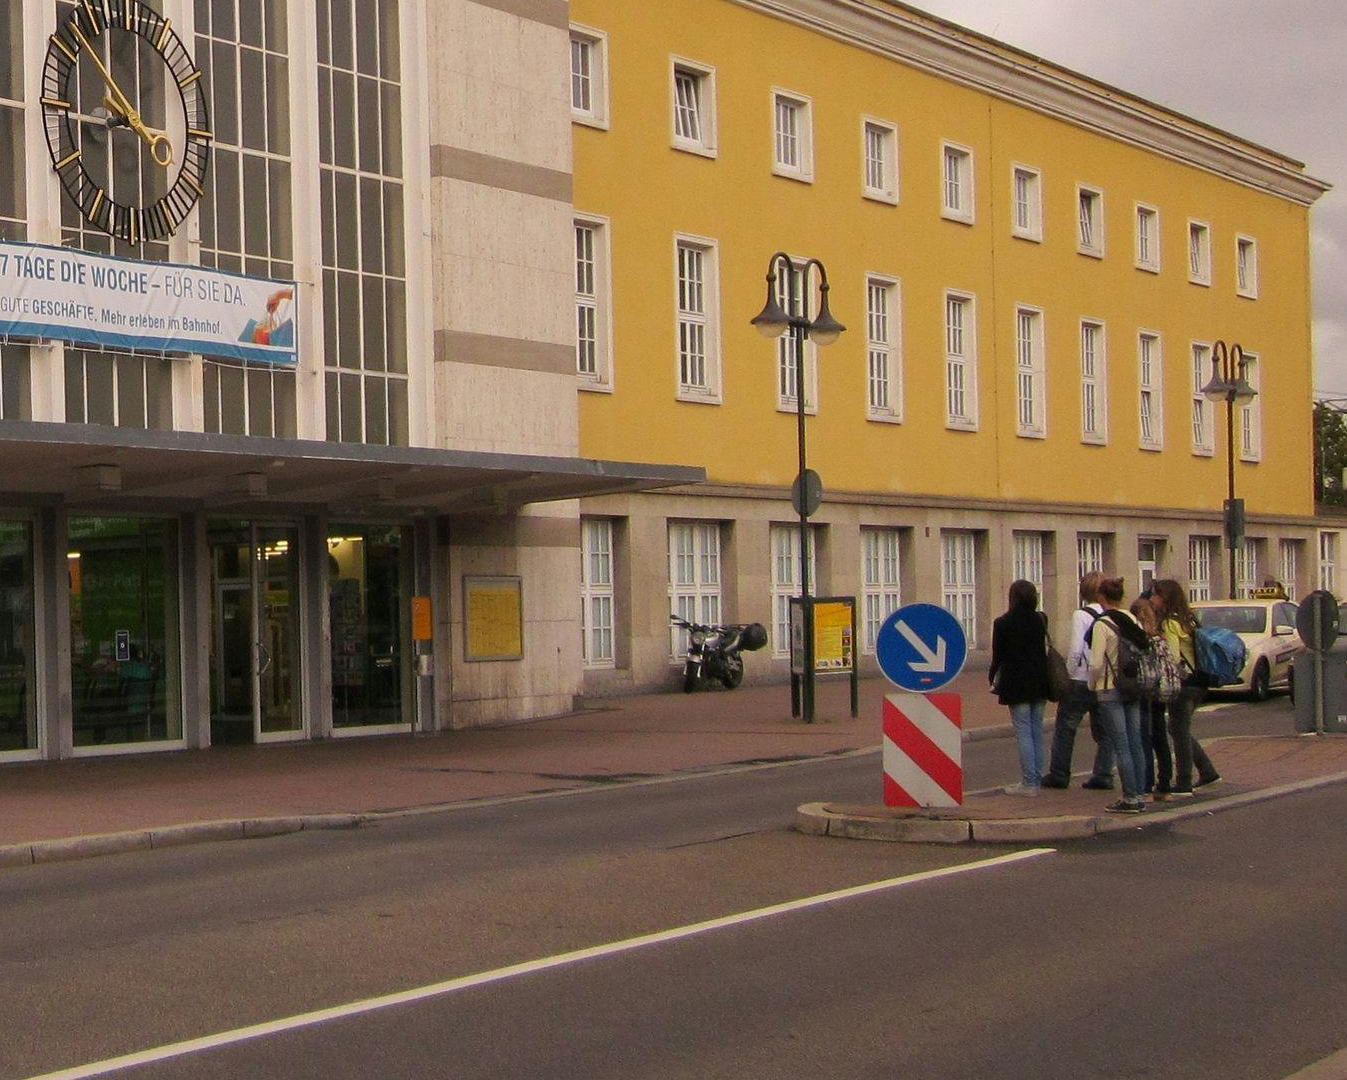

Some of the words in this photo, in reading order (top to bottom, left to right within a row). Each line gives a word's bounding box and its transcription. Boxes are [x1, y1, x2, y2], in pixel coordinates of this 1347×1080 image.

[0, 254, 9, 276] 7
[14, 255, 56, 281] TAGE
[60, 261, 86, 285] DIE
[91, 265, 147, 294] WOCHE
[164, 271, 194, 299] FÜR
[197, 278, 220, 302] SIE
[223, 282, 246, 307] DA.
[0, 296, 29, 314] GUTE
[32, 299, 97, 322] GESCHÄFTE.
[101, 308, 126, 326] Mehr
[129, 313, 165, 329] erleben
[167, 315, 180, 330] im
[182, 316, 223, 335] Bahnhof.
